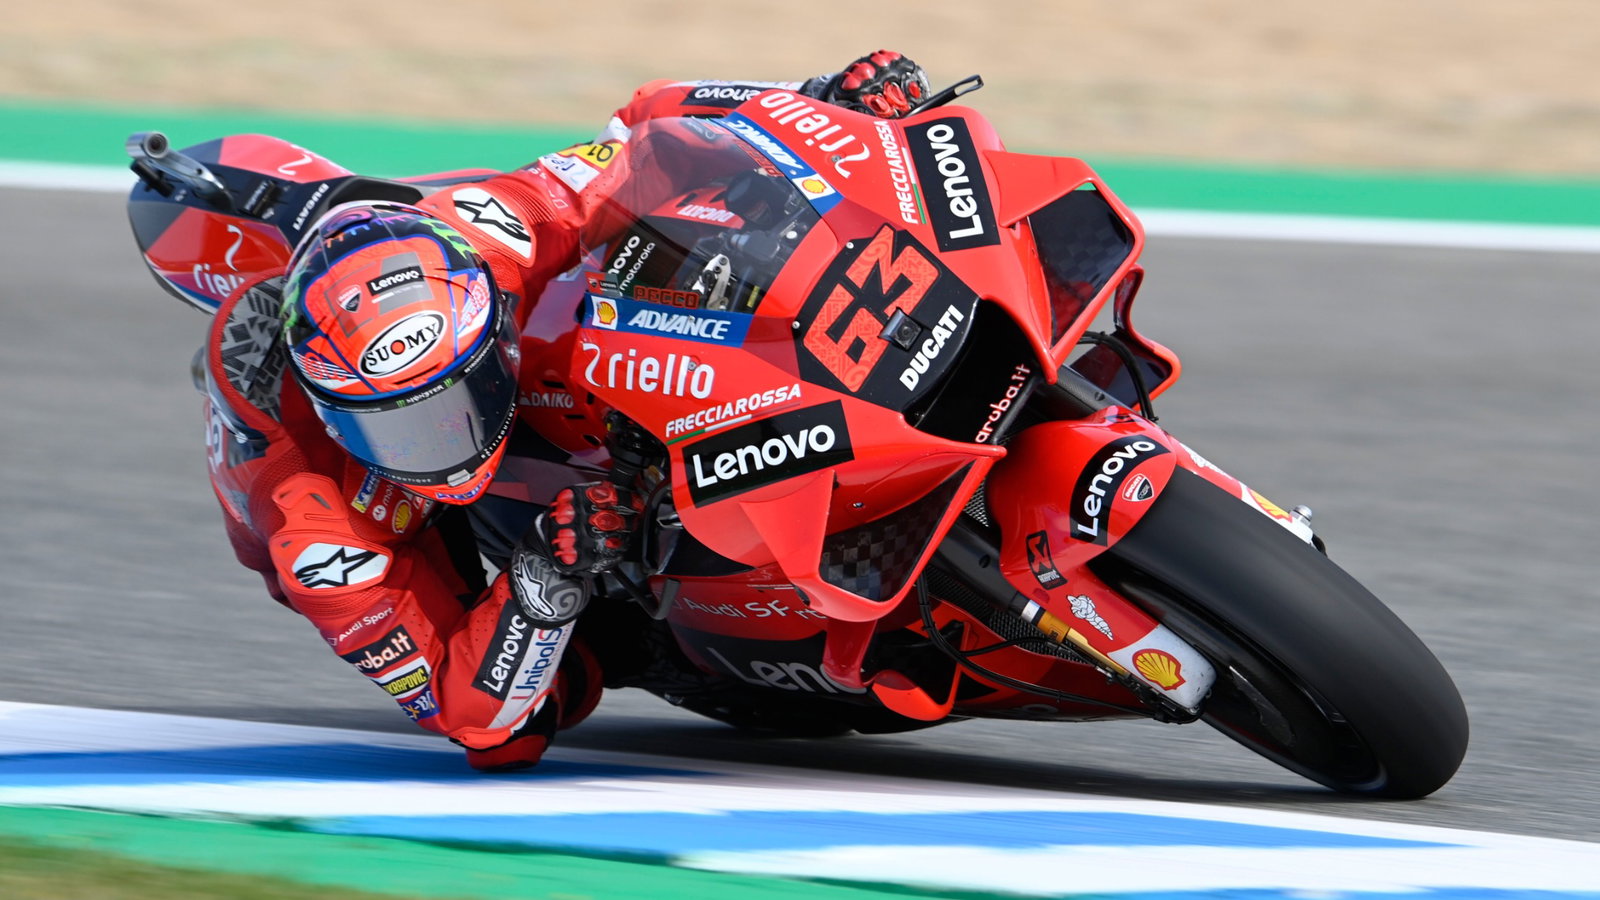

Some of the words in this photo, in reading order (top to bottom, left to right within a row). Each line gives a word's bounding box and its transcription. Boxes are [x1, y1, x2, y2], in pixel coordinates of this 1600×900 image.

[692, 86, 762, 102] enovo
[758, 91, 856, 153] riello
[873, 120, 919, 225] FRECCIAROSSA
[926, 123, 985, 241] Lenovo
[292, 182, 330, 231] DUCATI
[676, 203, 736, 223] DUCATI
[370, 269, 420, 292] Lenovo
[633, 285, 700, 310] PECCO
[627, 308, 732, 341] ADVANCE
[802, 224, 941, 393] 63
[364, 322, 438, 367] SUOMY
[899, 303, 965, 392] DUCATI
[606, 347, 716, 400] riello
[665, 383, 802, 438] FRECCIAROSSA
[974, 363, 1031, 444] aruba.it
[692, 424, 836, 489] Lenovo
[1077, 440, 1156, 538] Lenovo
[338, 621, 363, 642] Audi
[362, 607, 394, 625] Sport
[682, 597, 748, 619] Audi
